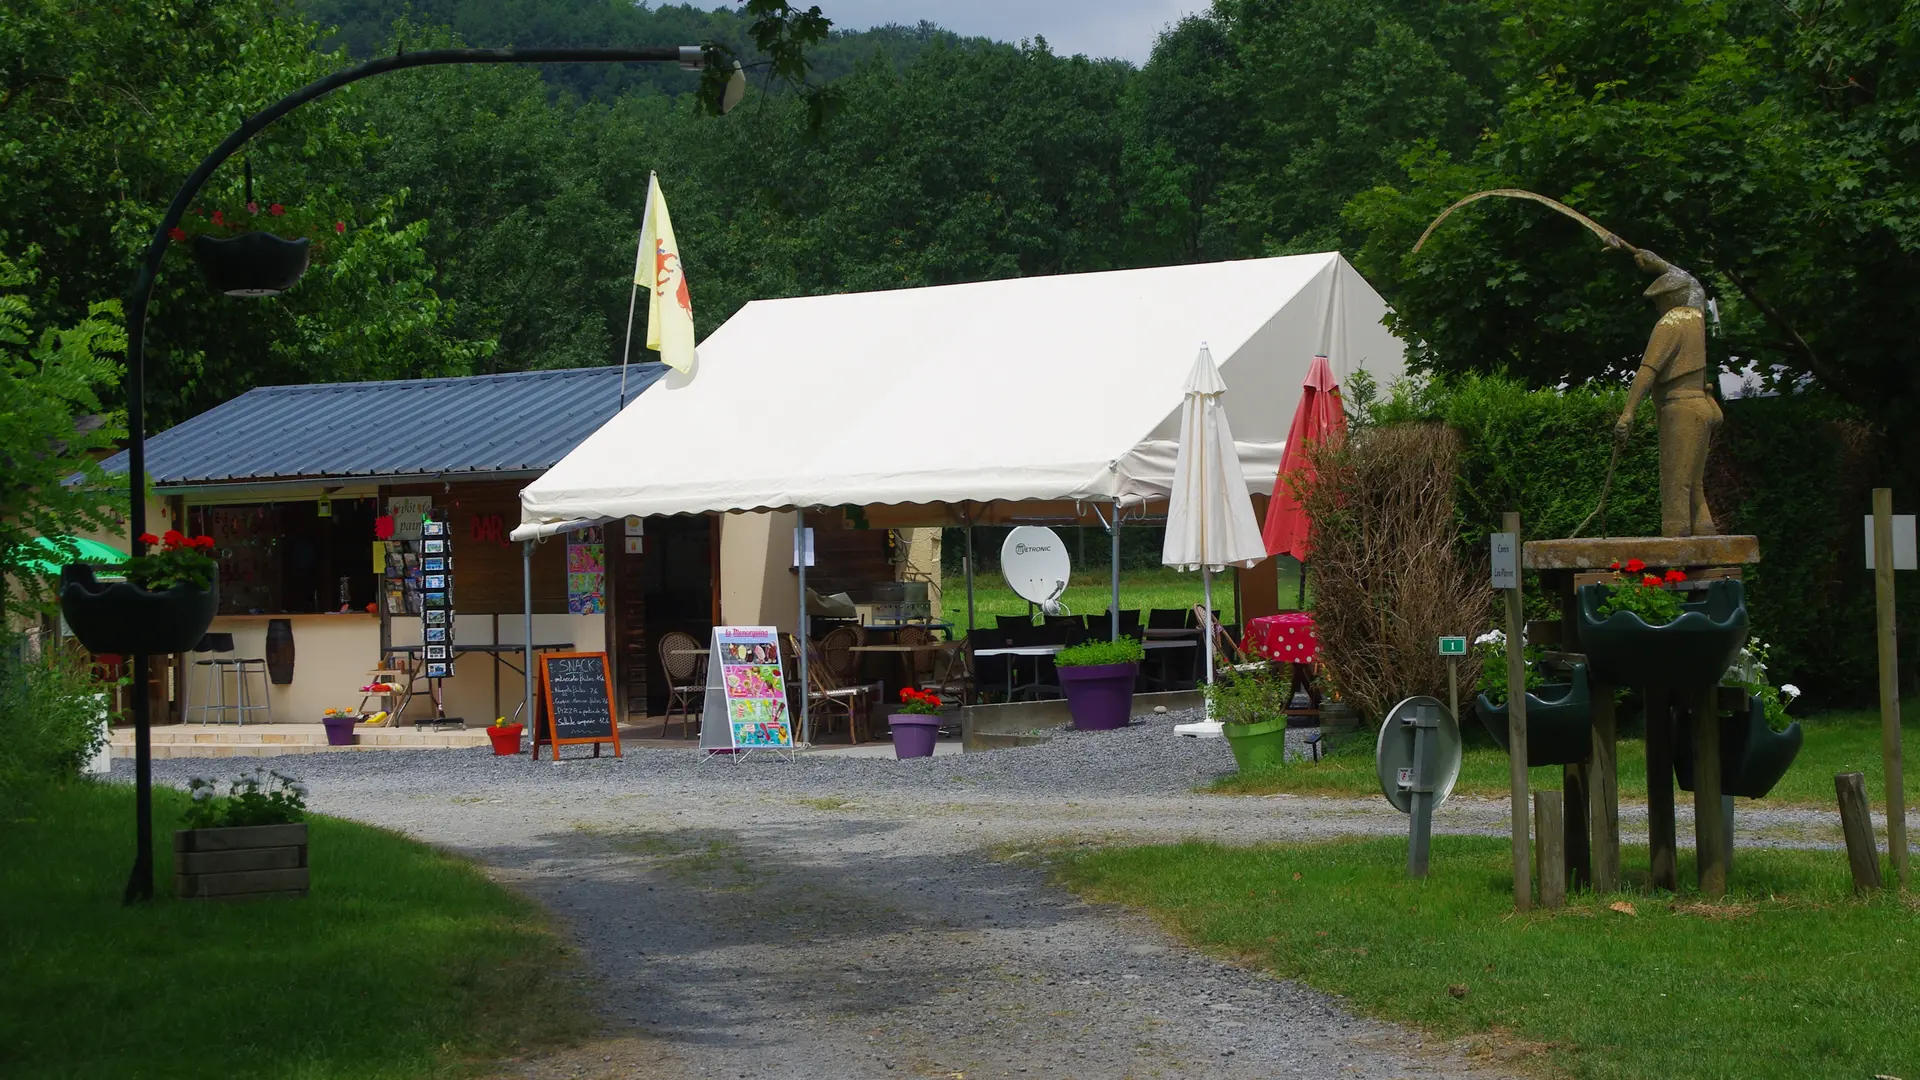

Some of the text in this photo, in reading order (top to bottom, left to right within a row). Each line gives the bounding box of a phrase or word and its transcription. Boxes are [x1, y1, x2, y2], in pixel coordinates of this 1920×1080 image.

[397, 520, 421, 535] pain
[470, 514, 508, 548] BAR
[1450, 641, 1455, 650] 1
[559, 659, 595, 672] SNACK
